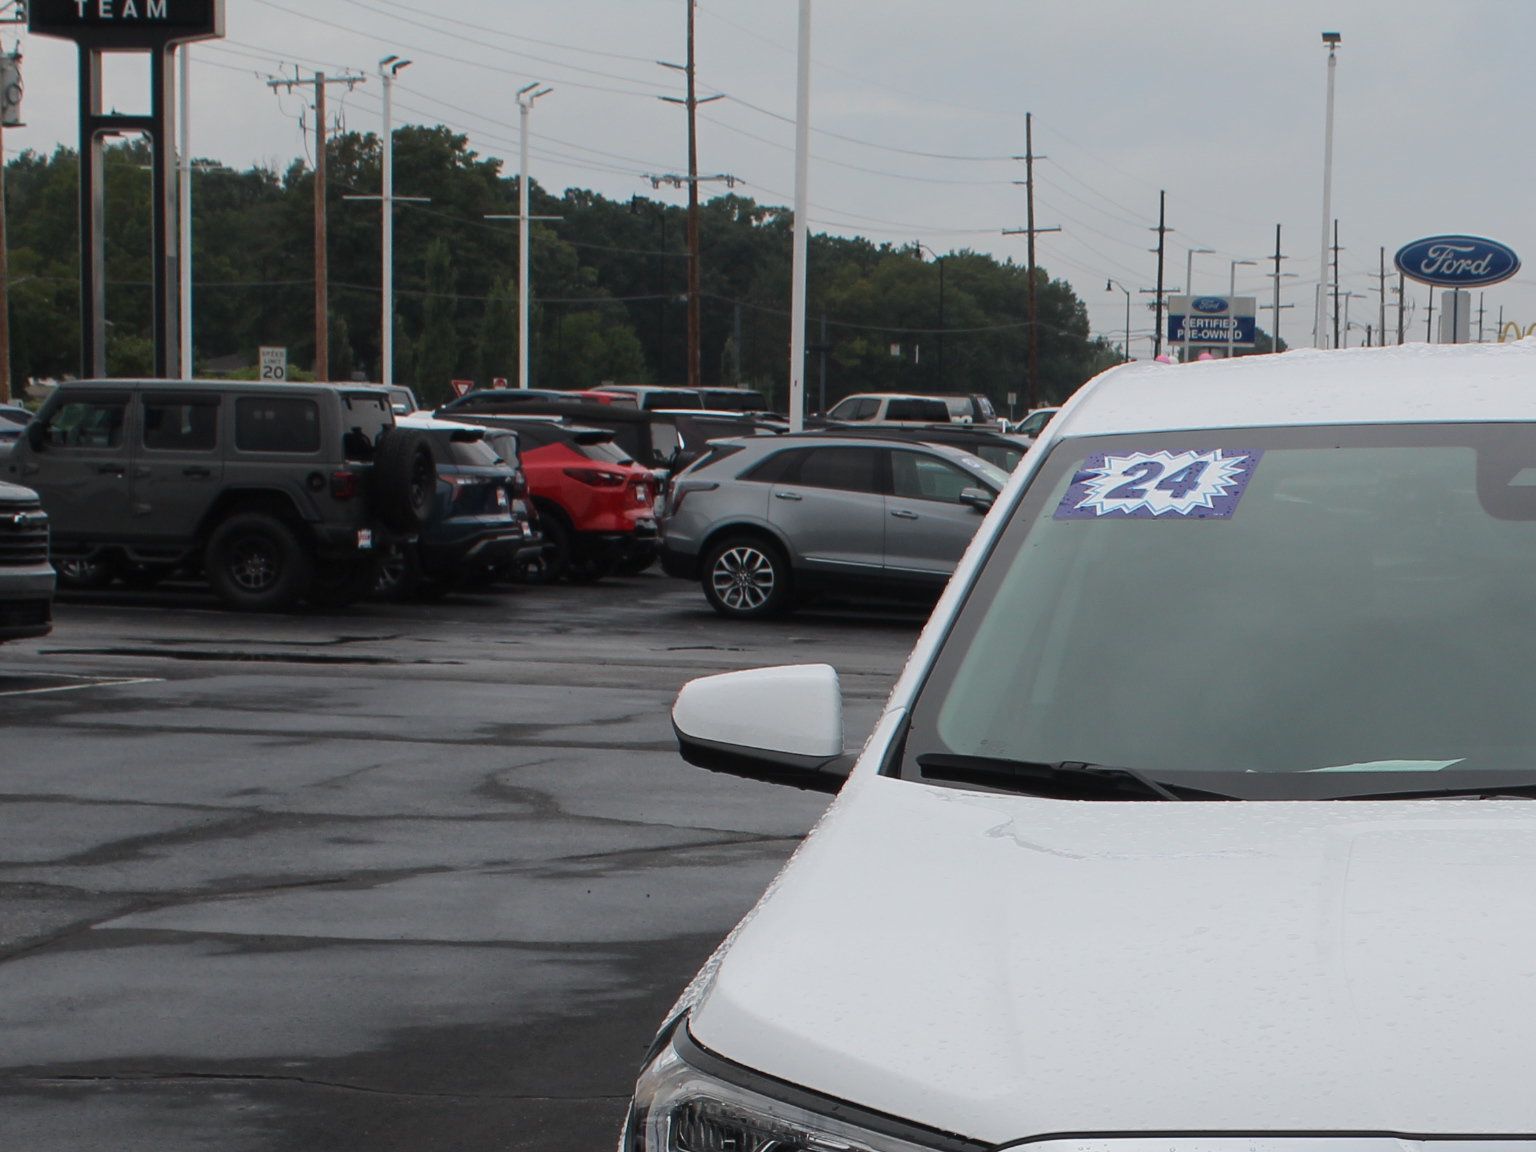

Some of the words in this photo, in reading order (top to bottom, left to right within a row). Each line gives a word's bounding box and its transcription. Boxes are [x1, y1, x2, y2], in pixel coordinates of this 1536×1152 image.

[74, 0, 168, 19] TEAM
[1420, 244, 1494, 275] Ford
[263, 365, 284, 379] 20
[1103, 460, 1211, 500] 24
